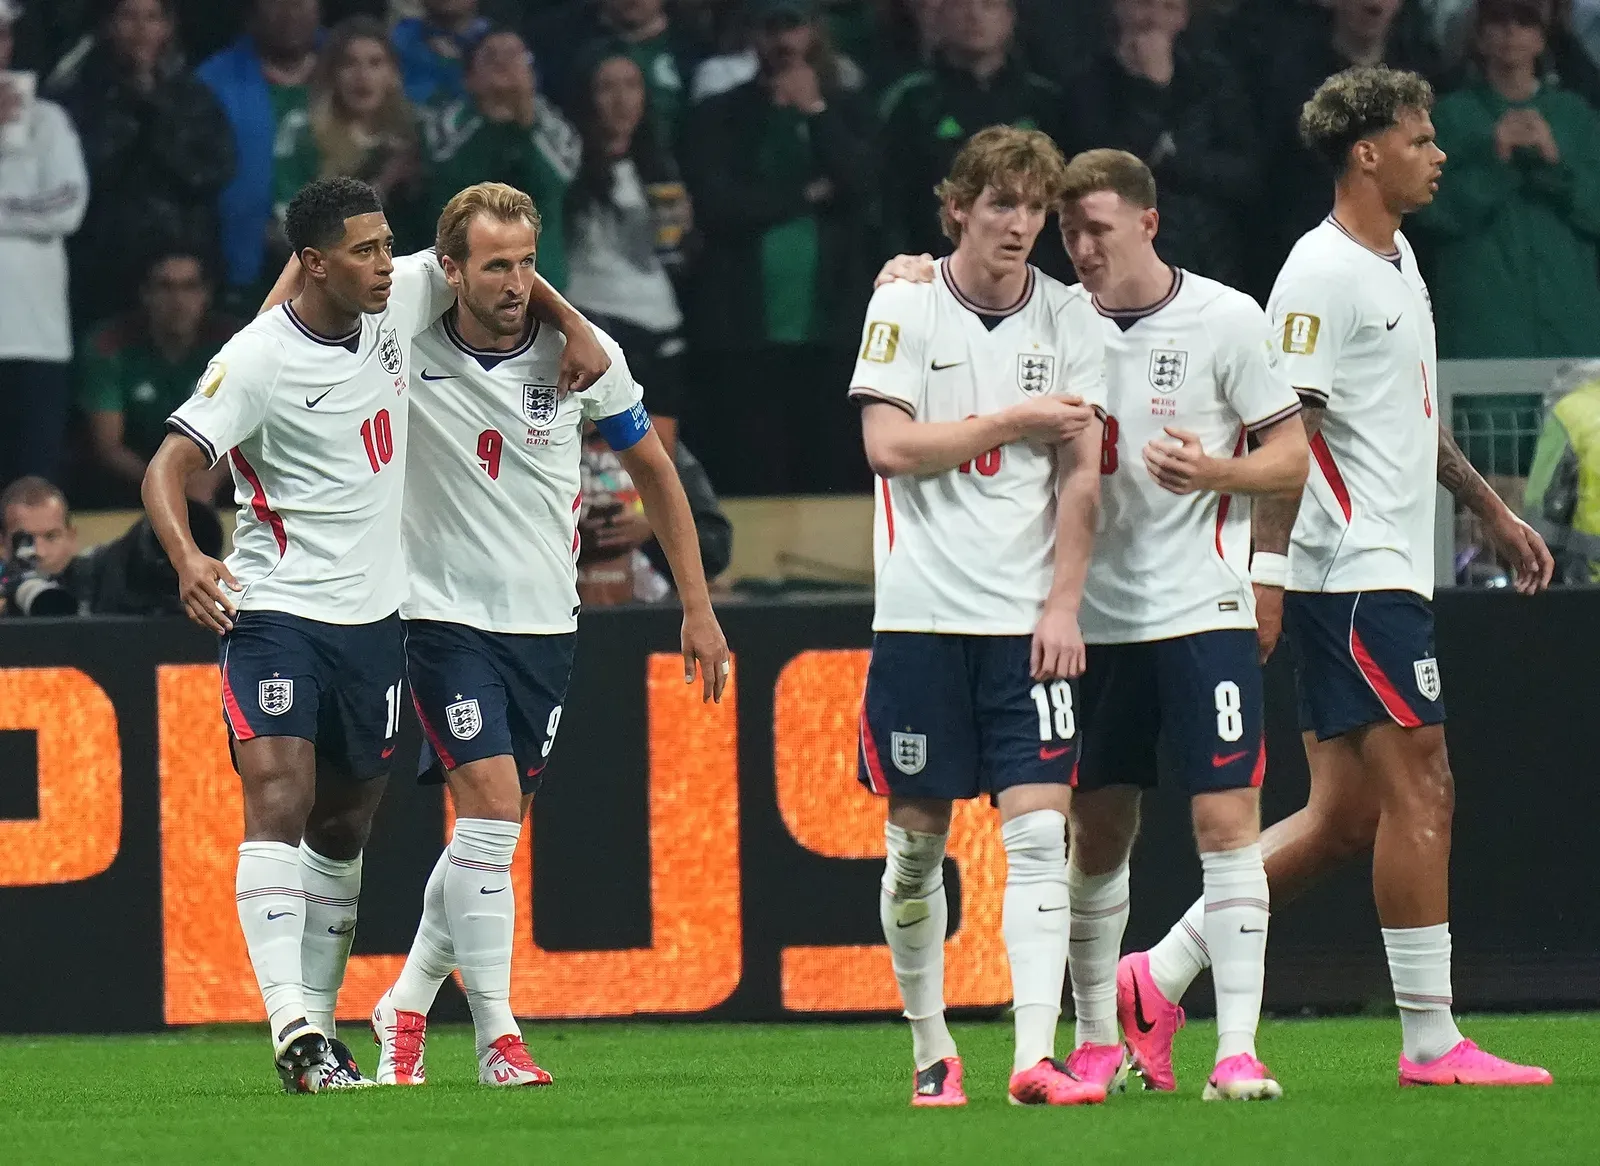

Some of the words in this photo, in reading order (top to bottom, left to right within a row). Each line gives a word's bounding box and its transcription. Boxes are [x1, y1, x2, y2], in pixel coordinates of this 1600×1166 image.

[360, 407, 394, 475] 10
[476, 428, 504, 481] 9
[527, 428, 551, 437] MEXICO
[541, 705, 563, 758] 9
[1030, 679, 1076, 741] 18
[1214, 680, 1244, 742] 8
